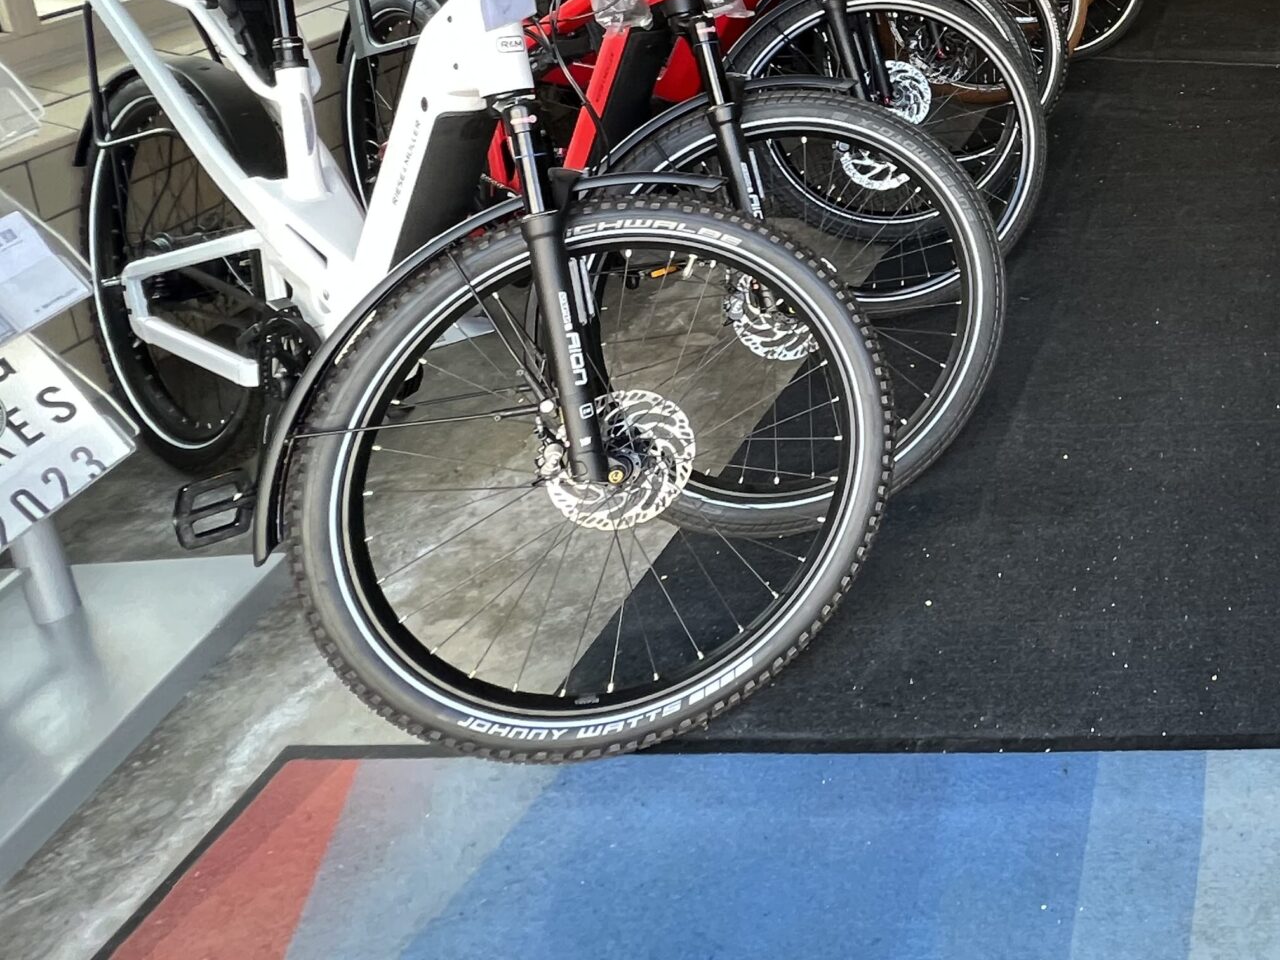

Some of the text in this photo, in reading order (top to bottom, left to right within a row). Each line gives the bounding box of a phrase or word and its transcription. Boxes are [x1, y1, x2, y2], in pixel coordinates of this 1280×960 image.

[932, 165, 977, 223] SUPER
[565, 331, 588, 386] AION
[457, 698, 682, 742] JOHNNY WATTS
